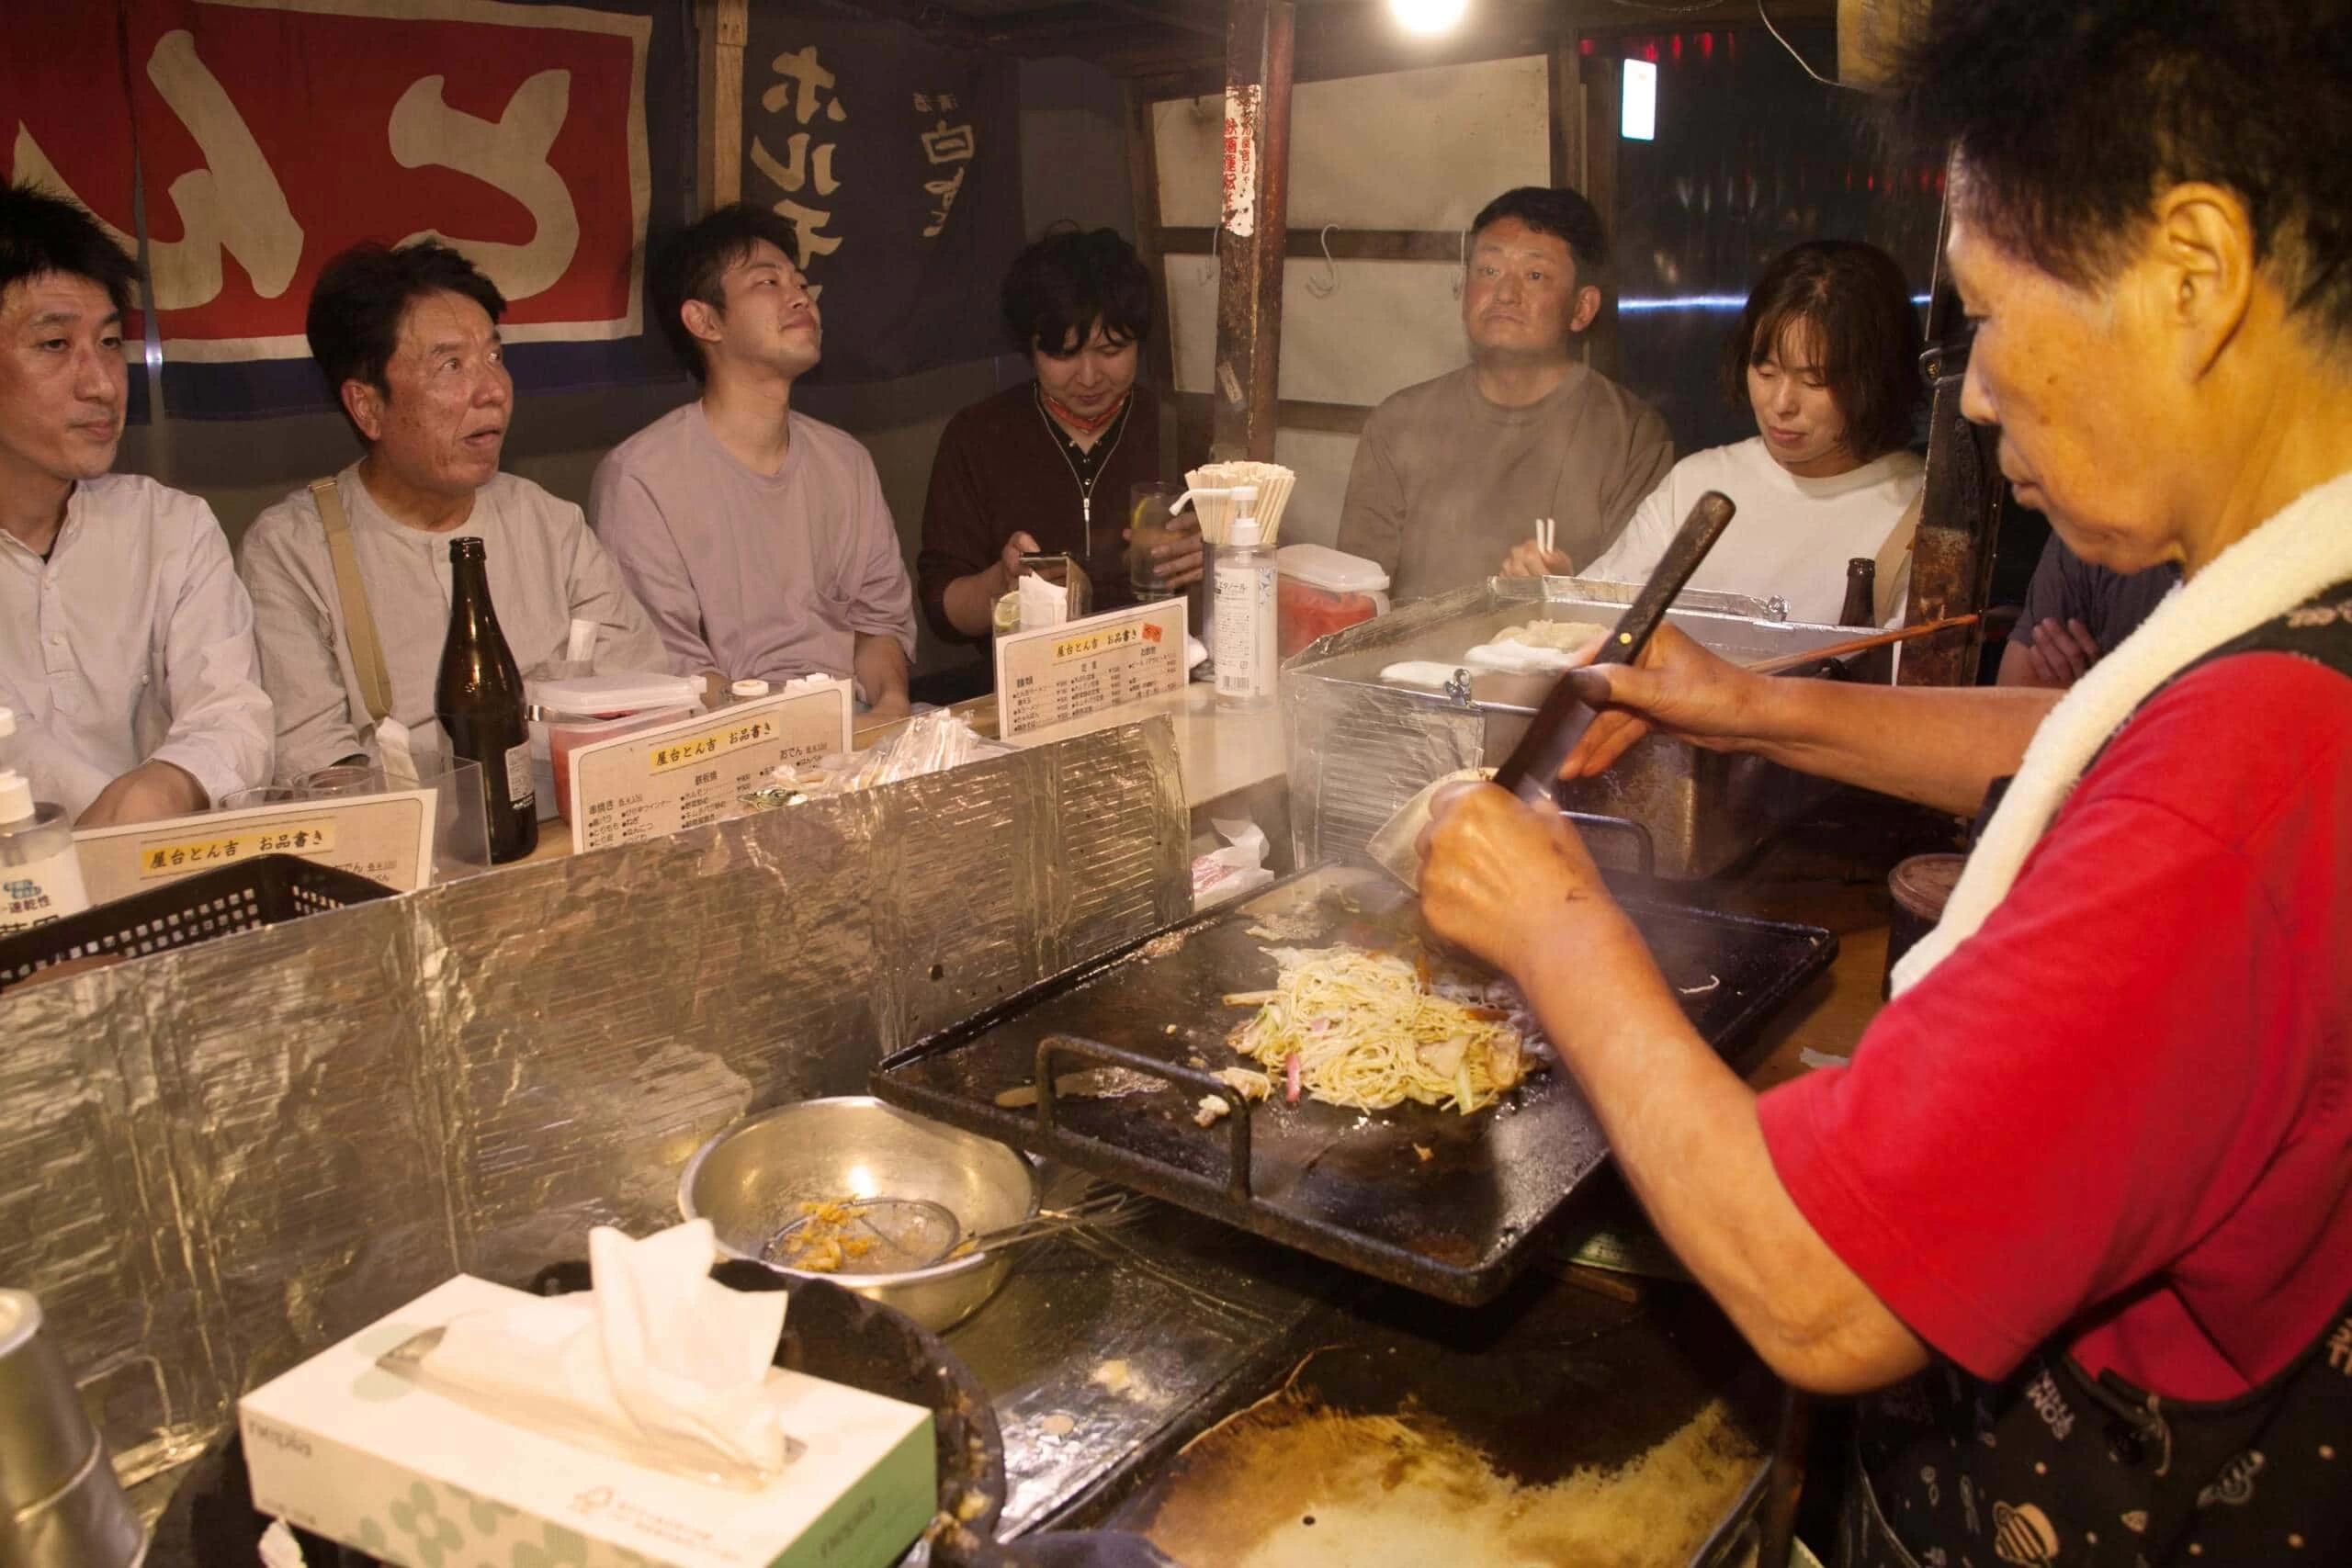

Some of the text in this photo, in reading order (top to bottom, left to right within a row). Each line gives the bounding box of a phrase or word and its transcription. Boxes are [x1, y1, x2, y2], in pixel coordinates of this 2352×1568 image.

[1057, 637, 1099, 658] 屋台とん吉
[1107, 629, 1136, 645] お品書き
[657, 722, 772, 766] 屋台とん吉 お品書き
[150, 829, 323, 869] 屋台とん吉 お品書き
[8, 895, 51, 914] 速乾性
